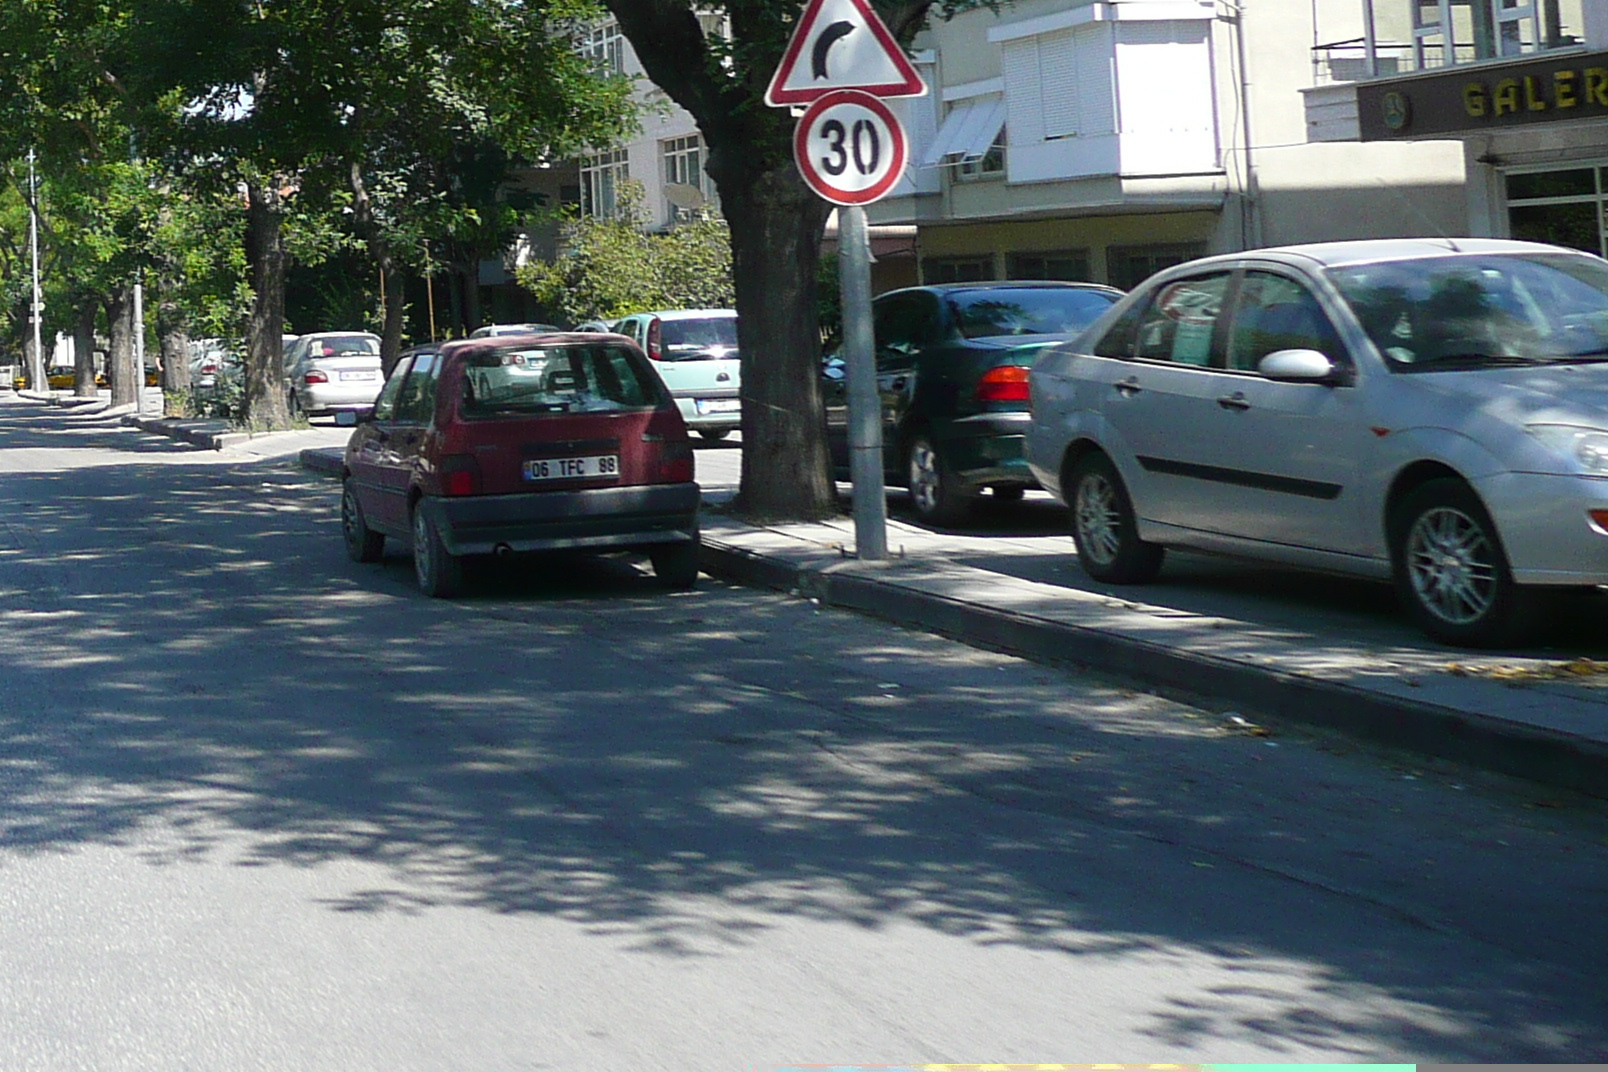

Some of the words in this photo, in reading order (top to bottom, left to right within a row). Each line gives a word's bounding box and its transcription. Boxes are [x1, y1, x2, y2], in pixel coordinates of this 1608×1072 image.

[820, 119, 880, 176] 30
[532, 462, 549, 477] 06
[558, 459, 585, 476] TFC
[598, 457, 615, 473] 88
